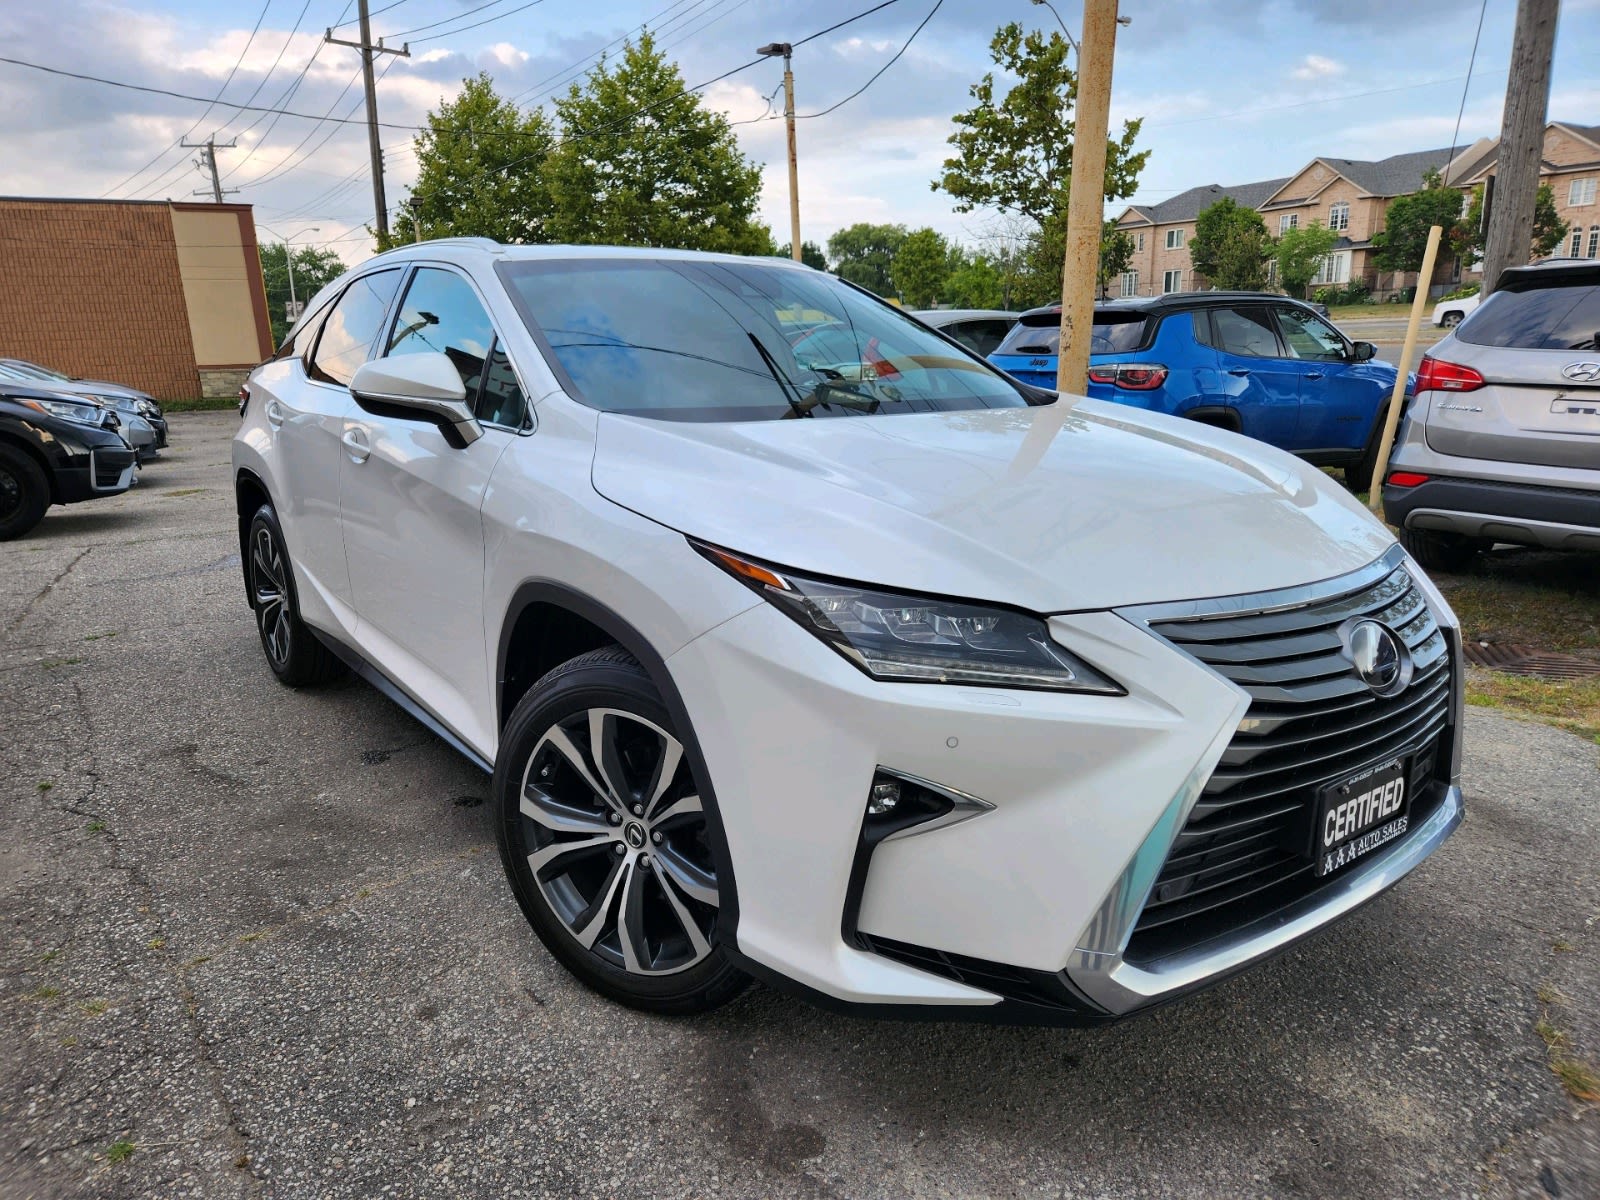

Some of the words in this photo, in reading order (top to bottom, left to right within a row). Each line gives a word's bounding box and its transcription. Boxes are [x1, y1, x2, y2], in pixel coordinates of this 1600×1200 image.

[1030, 357, 1048, 368] Jeep
[1324, 777, 1404, 847] CERTIFIED
[1358, 831, 1380, 851] AUTO
[1382, 816, 1408, 839] SALES
